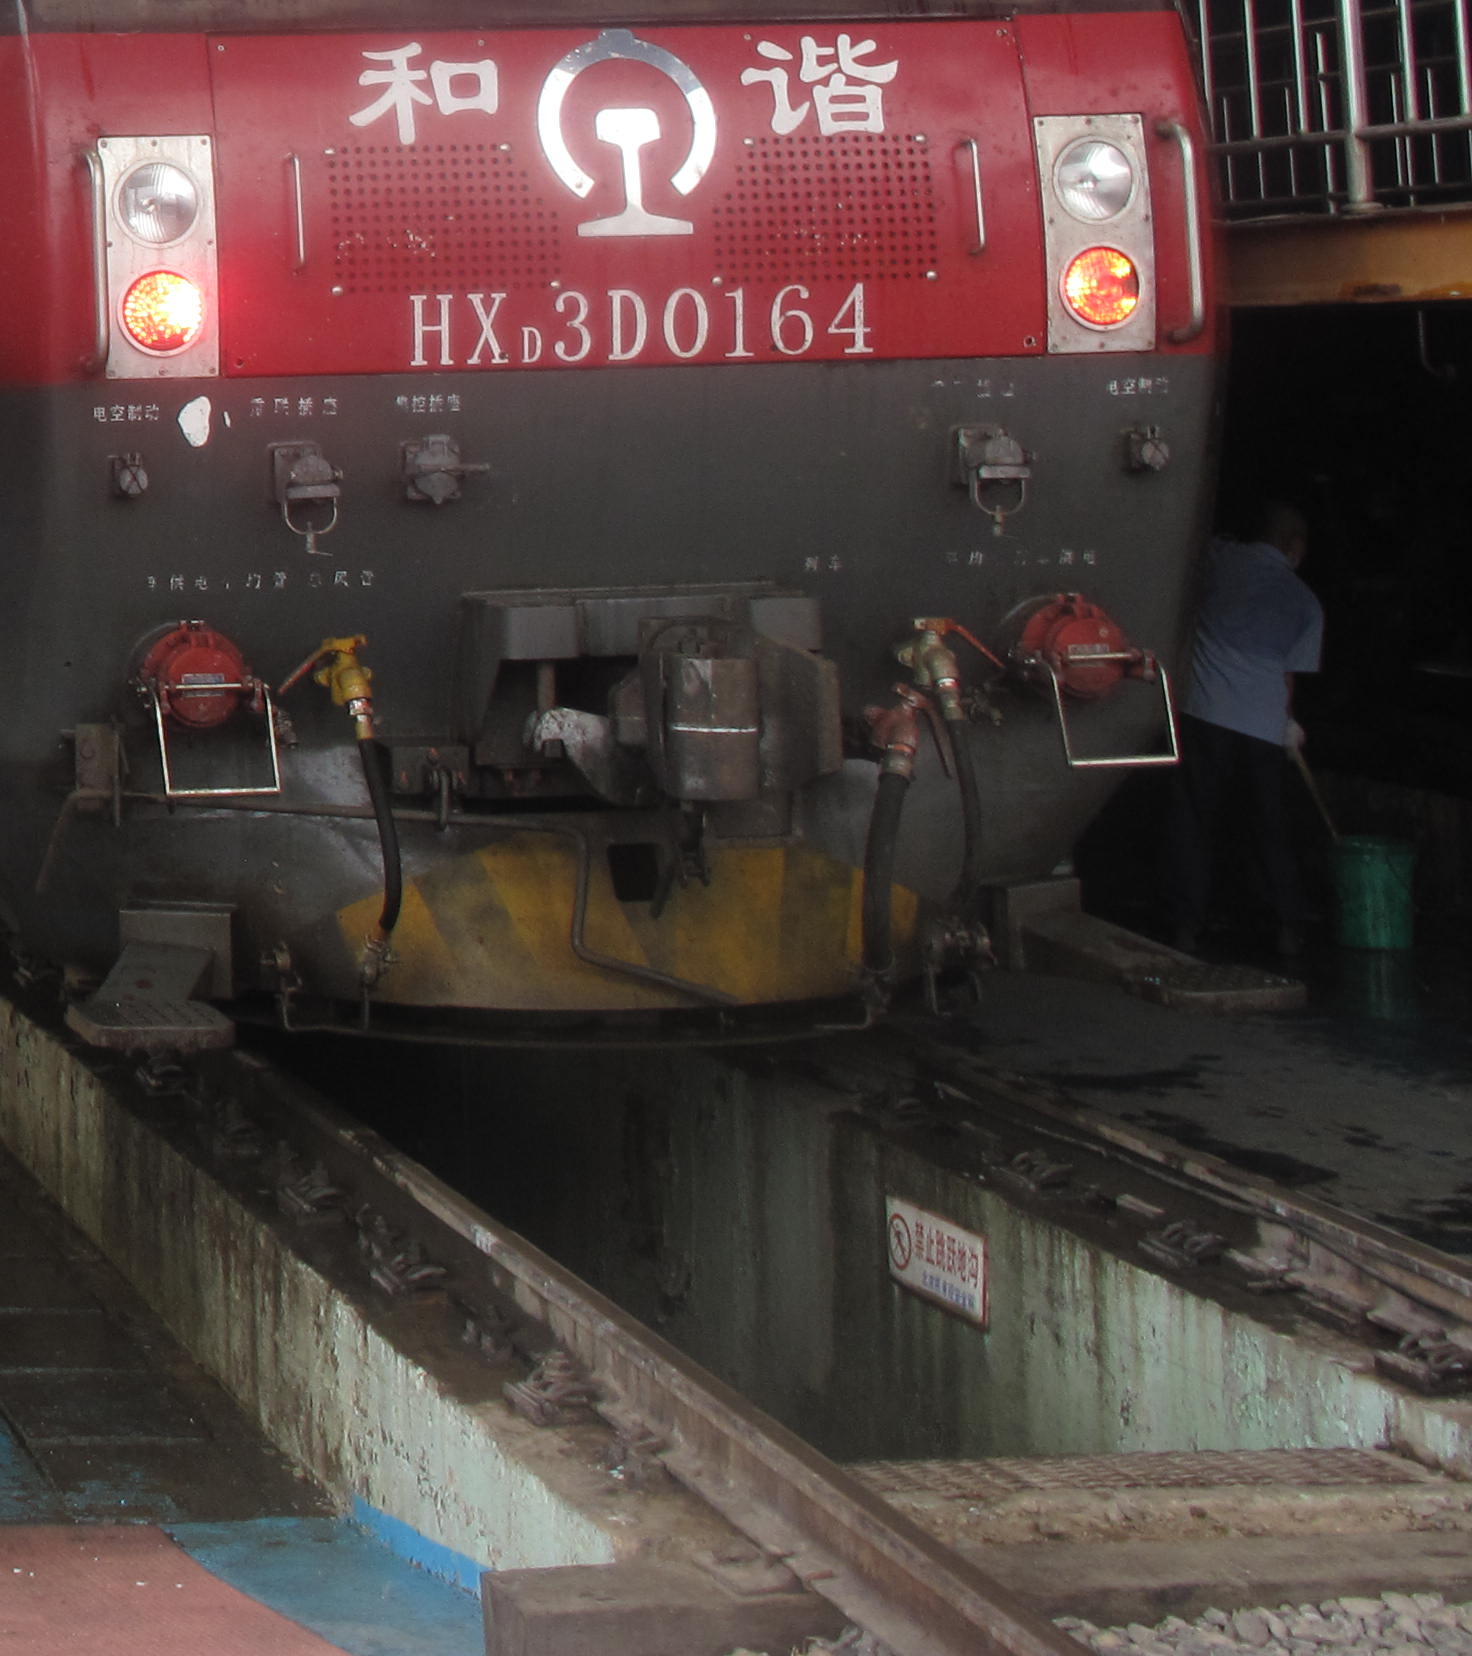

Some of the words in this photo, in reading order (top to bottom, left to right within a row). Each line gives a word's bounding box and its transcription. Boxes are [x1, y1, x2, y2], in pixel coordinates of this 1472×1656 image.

[348, 41, 499, 145] 和
[741, 33, 899, 136] 谐
[409, 282, 874, 367] HXD3D0164
